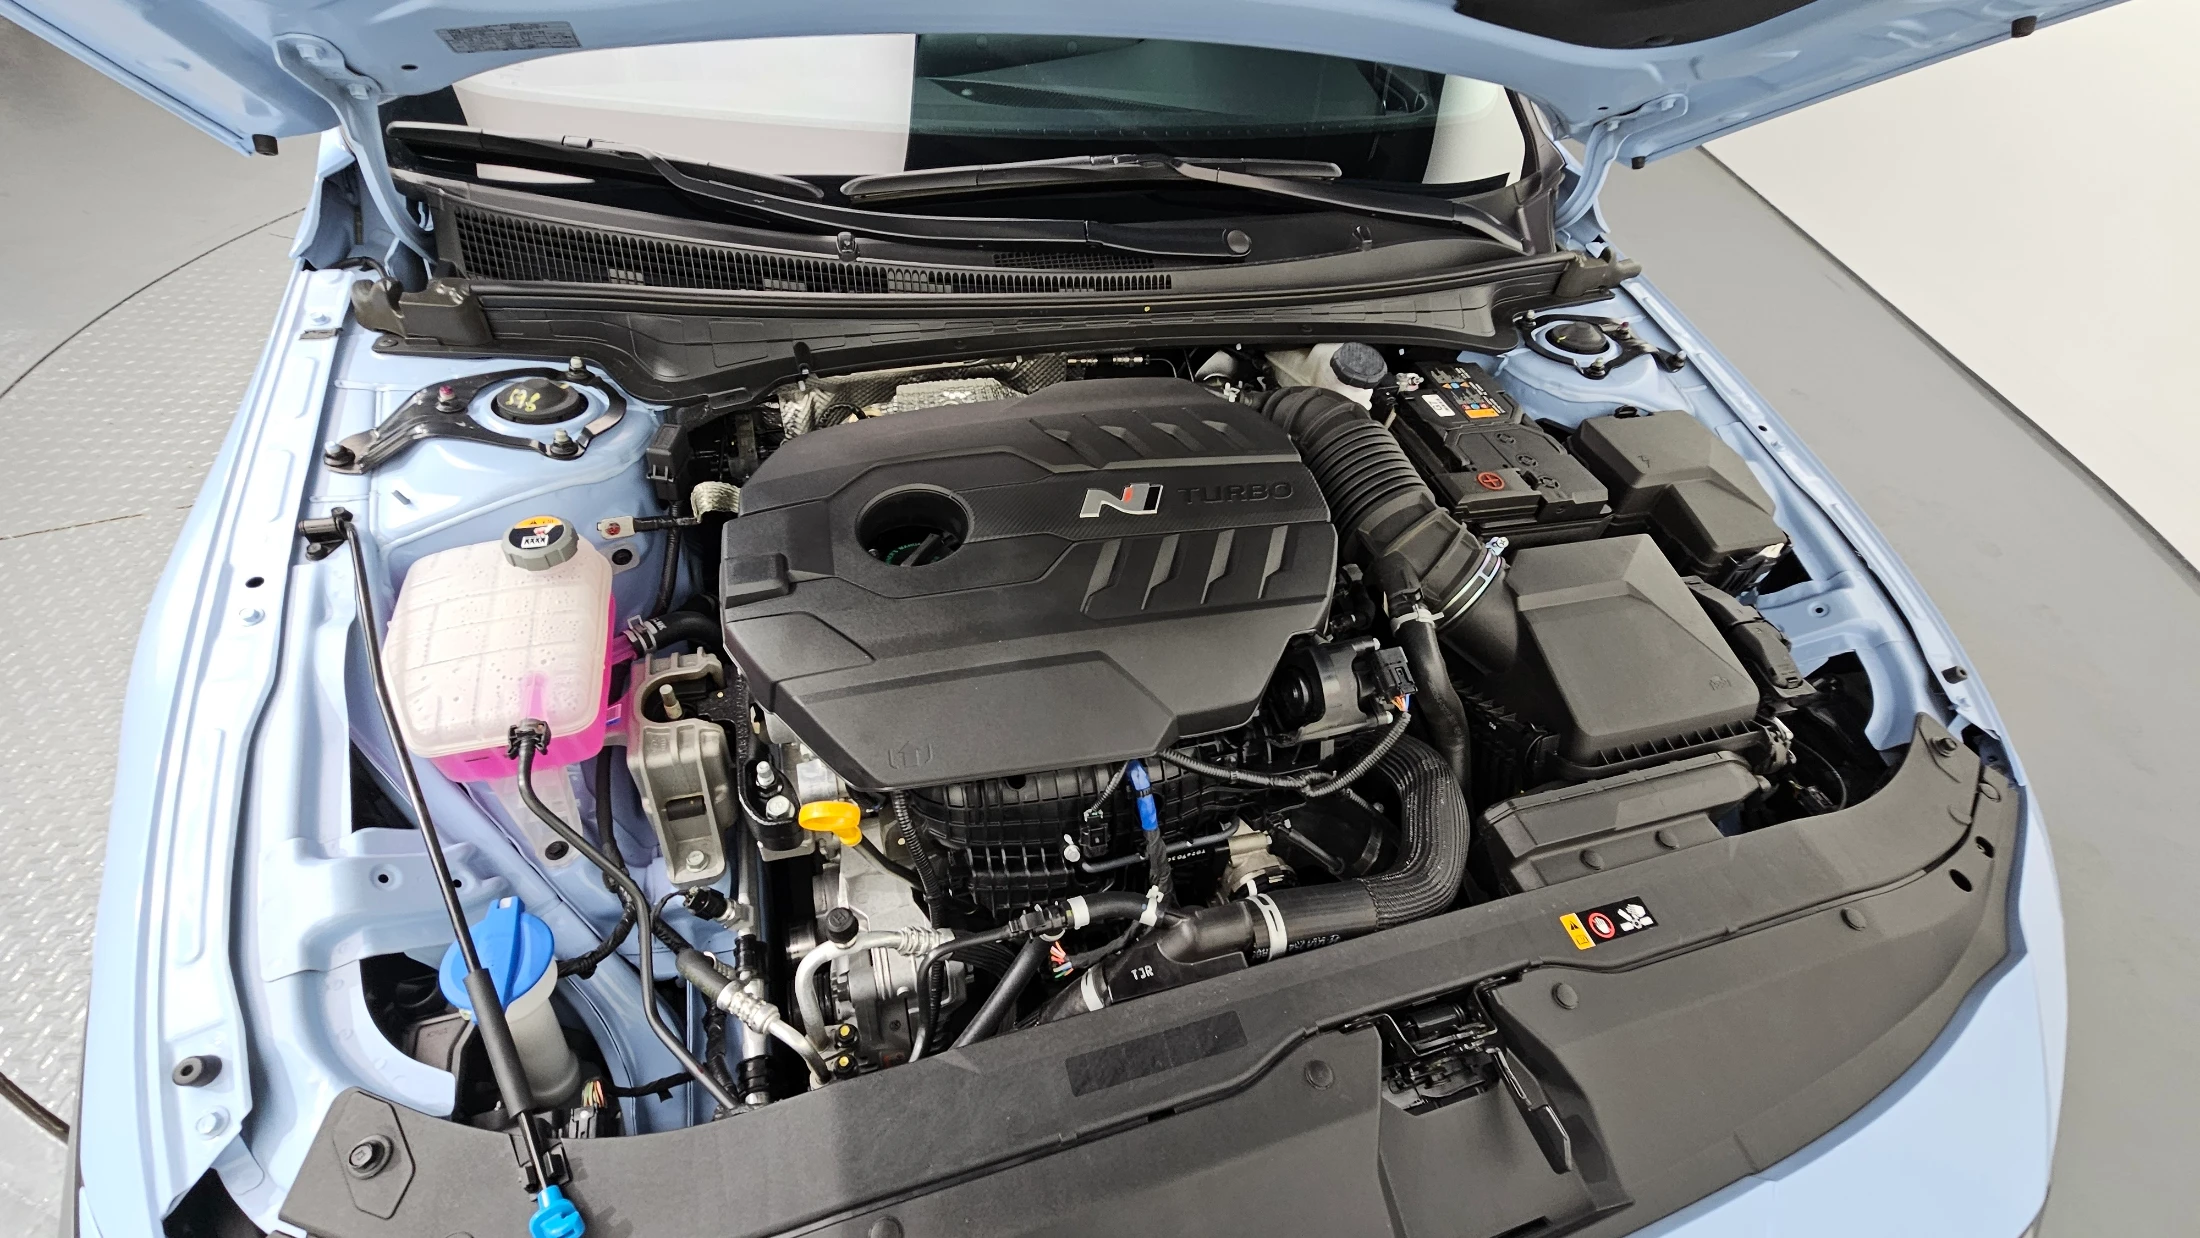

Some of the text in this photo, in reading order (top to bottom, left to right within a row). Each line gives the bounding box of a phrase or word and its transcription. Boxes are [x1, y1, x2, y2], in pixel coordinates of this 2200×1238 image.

[1079, 481, 1294, 518] N TURBO
[1131, 964, 1155, 981] TJR
